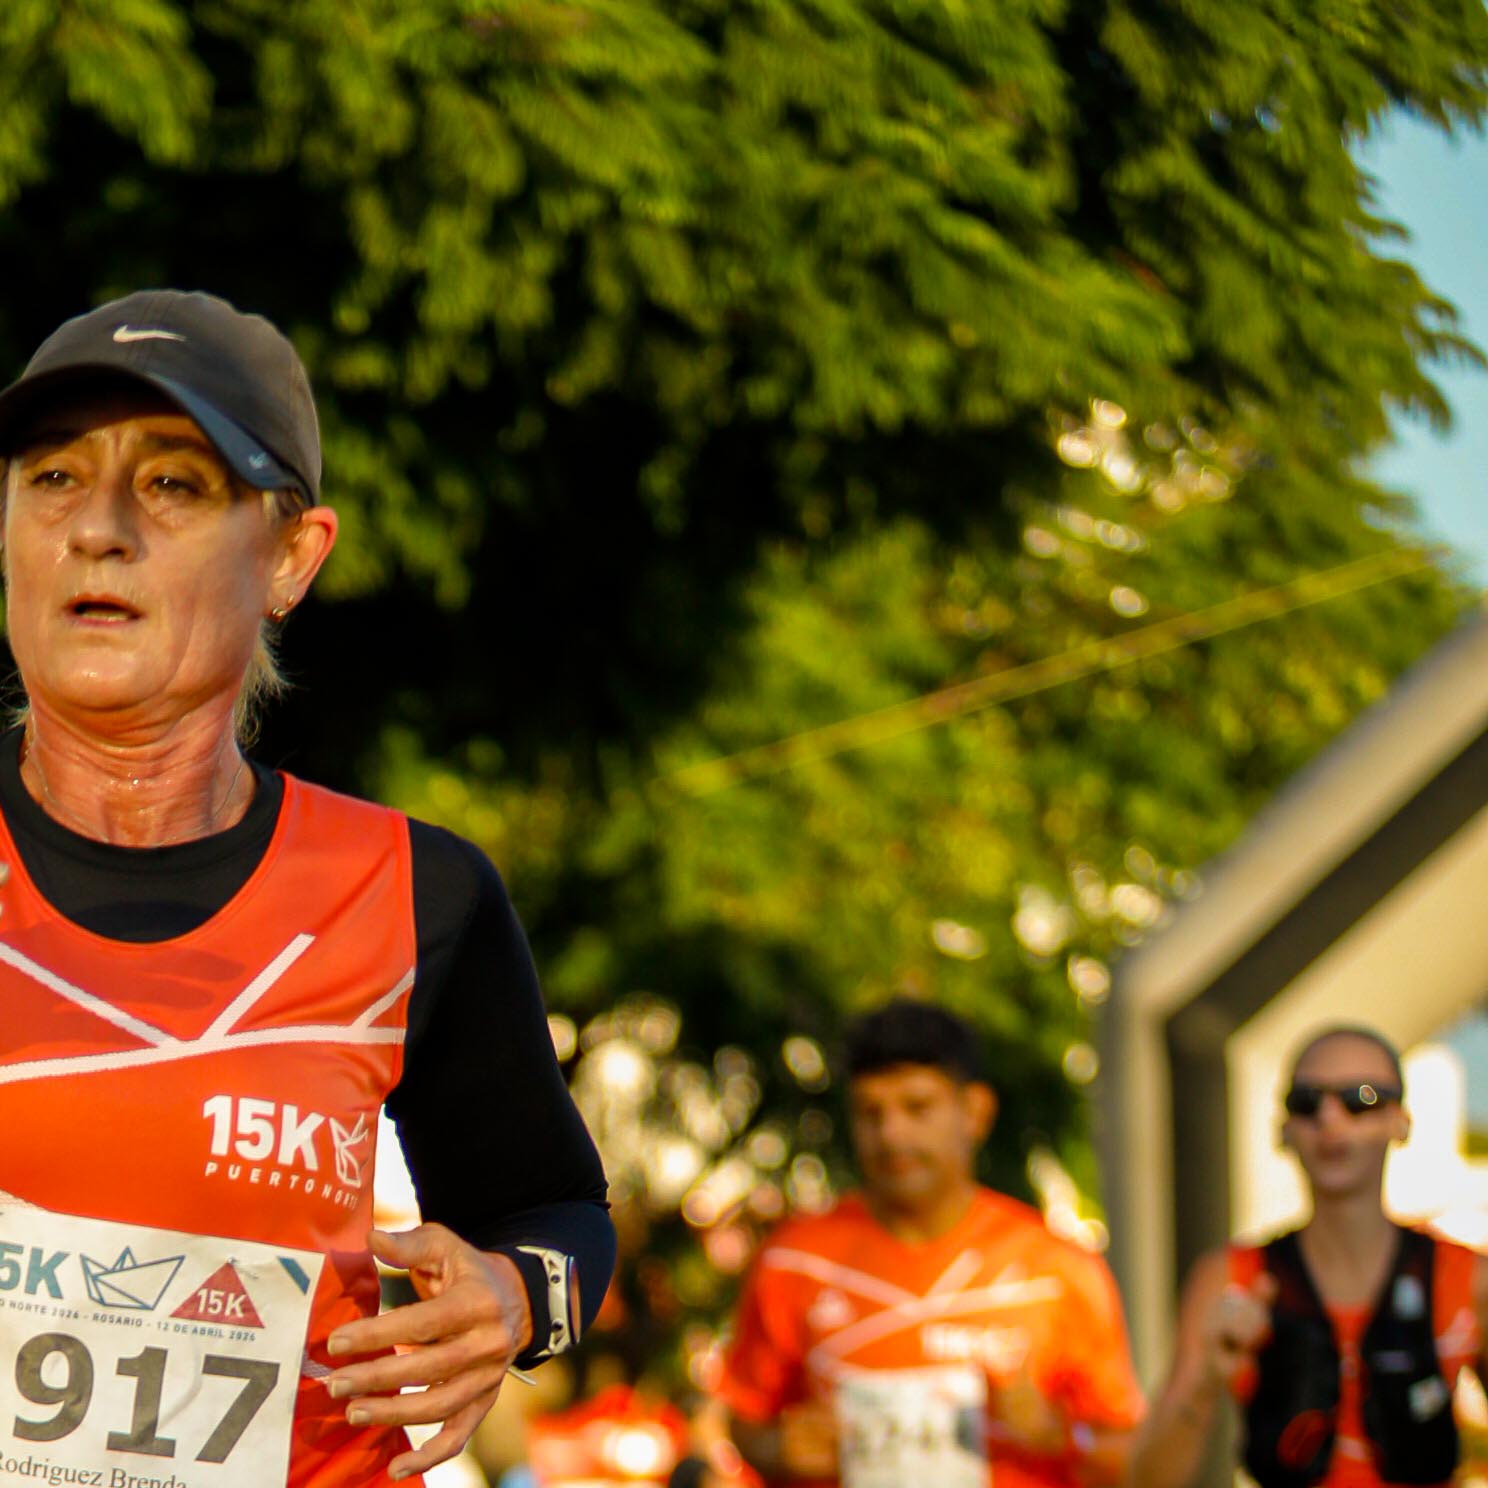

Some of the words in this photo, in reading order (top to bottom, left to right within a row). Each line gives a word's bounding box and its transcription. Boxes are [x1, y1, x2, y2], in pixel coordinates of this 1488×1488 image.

[203, 1094, 325, 1171] 15K
[204, 1162, 314, 1194] PUERTO
[9, 1302, 48, 1315] NORTE
[93, 1311, 143, 1328] ROSARIO
[157, 1321, 169, 1332] 12
[173, 1324, 189, 1334] DE
[191, 1326, 225, 1338] ABRIL
[196, 1288, 247, 1318] 15K
